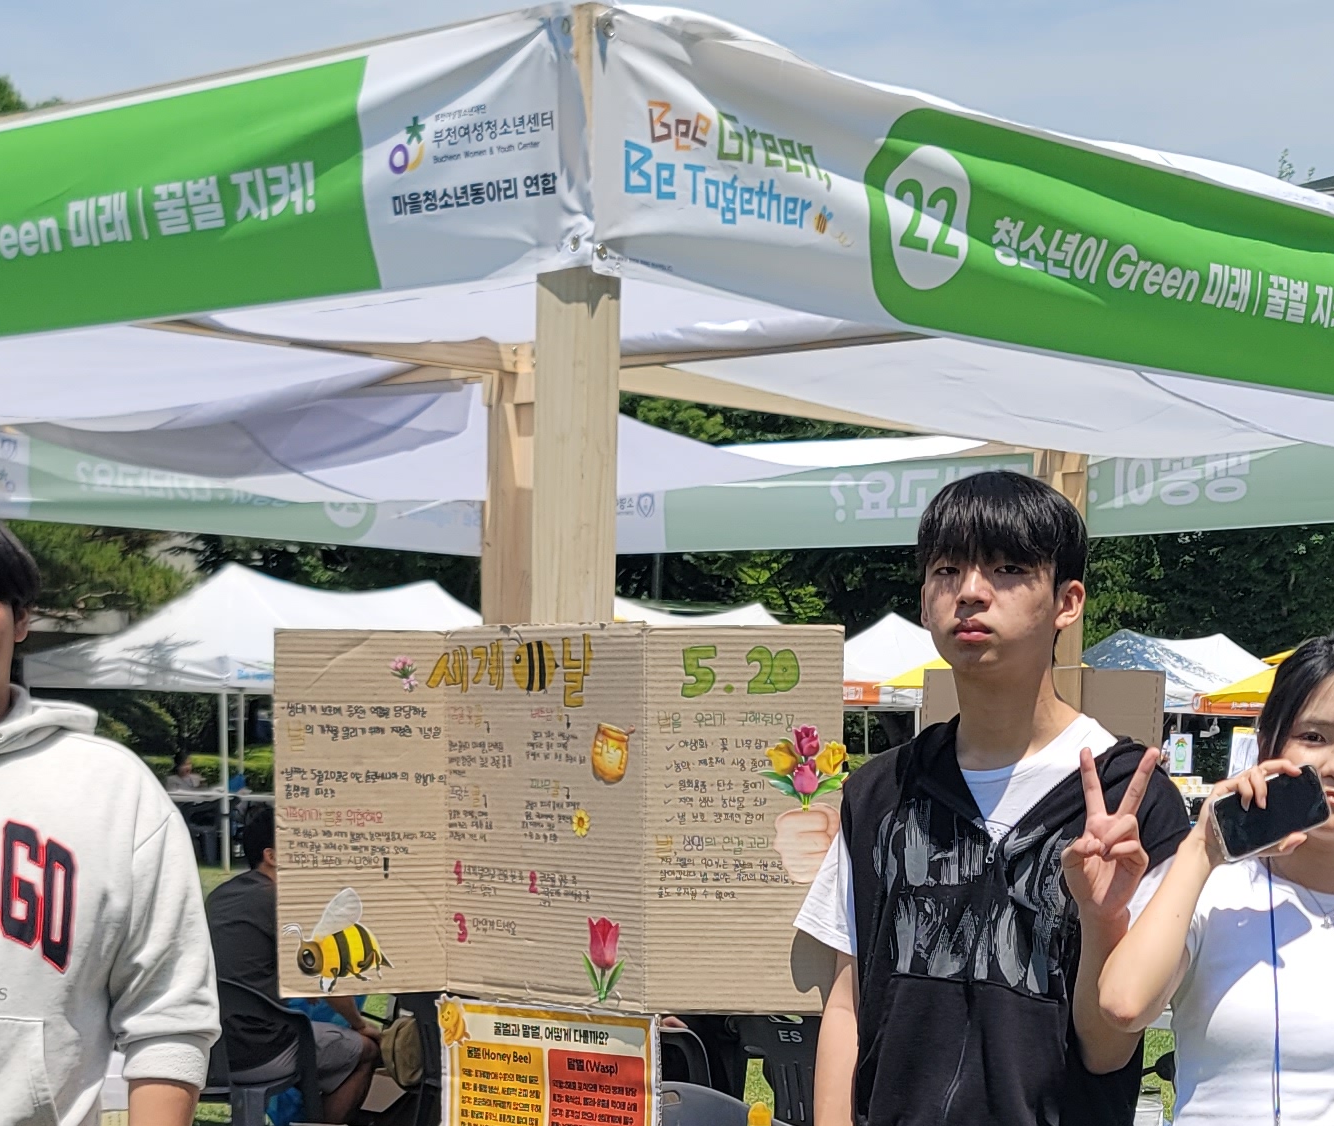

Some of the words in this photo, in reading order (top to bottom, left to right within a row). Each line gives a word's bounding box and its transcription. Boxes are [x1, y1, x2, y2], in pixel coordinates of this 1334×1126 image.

[432, 111, 554, 148] 부천여성청소년센터
[648, 101, 710, 150] Bee
[717, 111, 832, 191] Green,
[66, 190, 130, 248] 미래
[152, 176, 225, 237] 꿀벌
[231, 161, 316, 221] 지켜!
[392, 177, 518, 216] 마을청소년동아리
[523, 172, 557, 197] 연합
[624, 139, 675, 201] Be
[683, 163, 813, 230] Together
[894, 178, 960, 259] 22
[991, 216, 1108, 282] 청소년이
[1106, 244, 1199, 303] Green
[1202, 263, 1250, 314] 미래
[1265, 274, 1308, 324] 꿀벌
[426, 639, 504, 693] 세계
[563, 633, 593, 708] 날
[693, 712, 725, 727] 우리가
[544, 1027, 572, 1042] 어떻게
